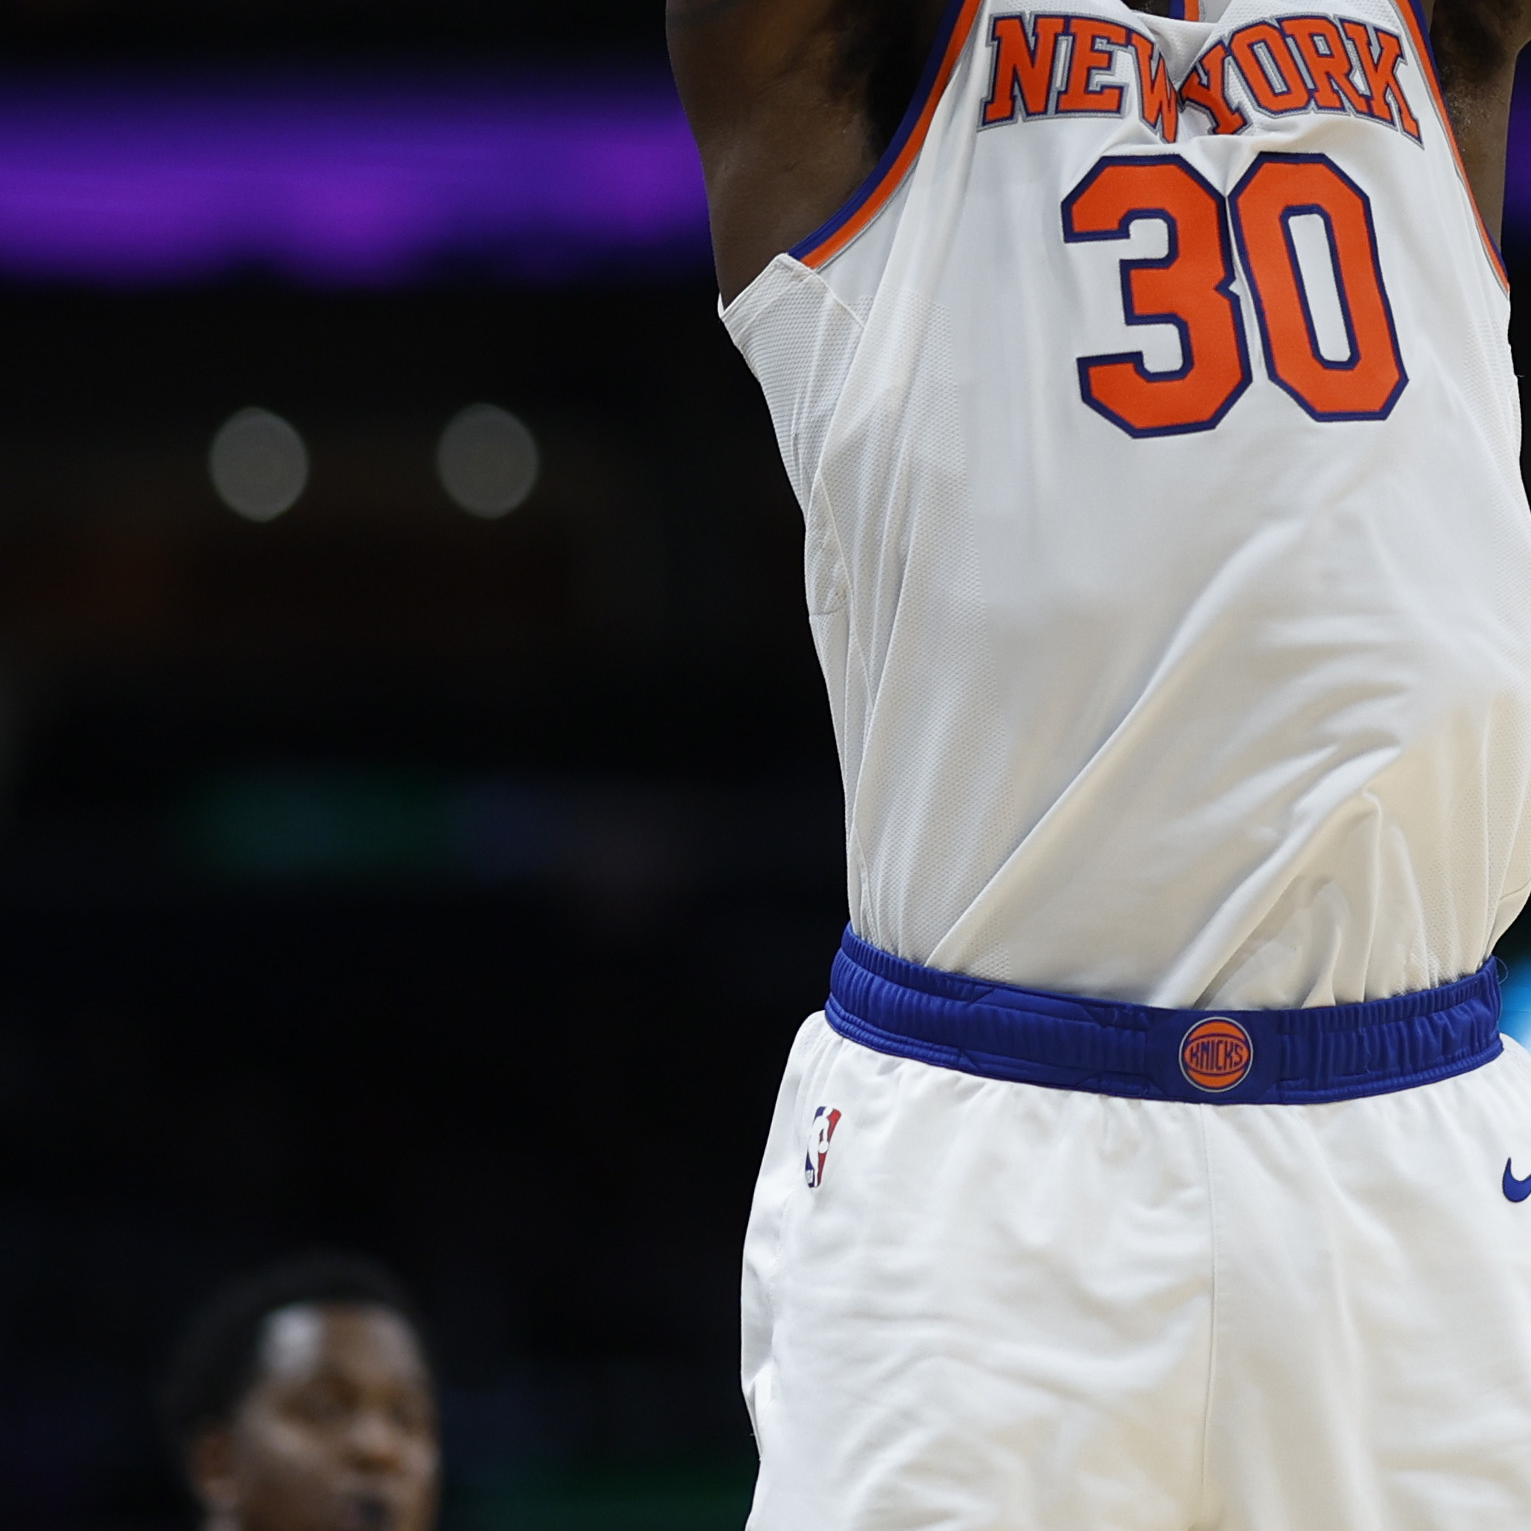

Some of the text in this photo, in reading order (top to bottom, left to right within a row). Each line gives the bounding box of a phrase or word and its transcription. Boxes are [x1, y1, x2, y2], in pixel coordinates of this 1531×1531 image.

[977, 11, 1425, 151] NEW YORK
[1060, 152, 1411, 440] 30
[1189, 1038, 1245, 1072] KNICKS
